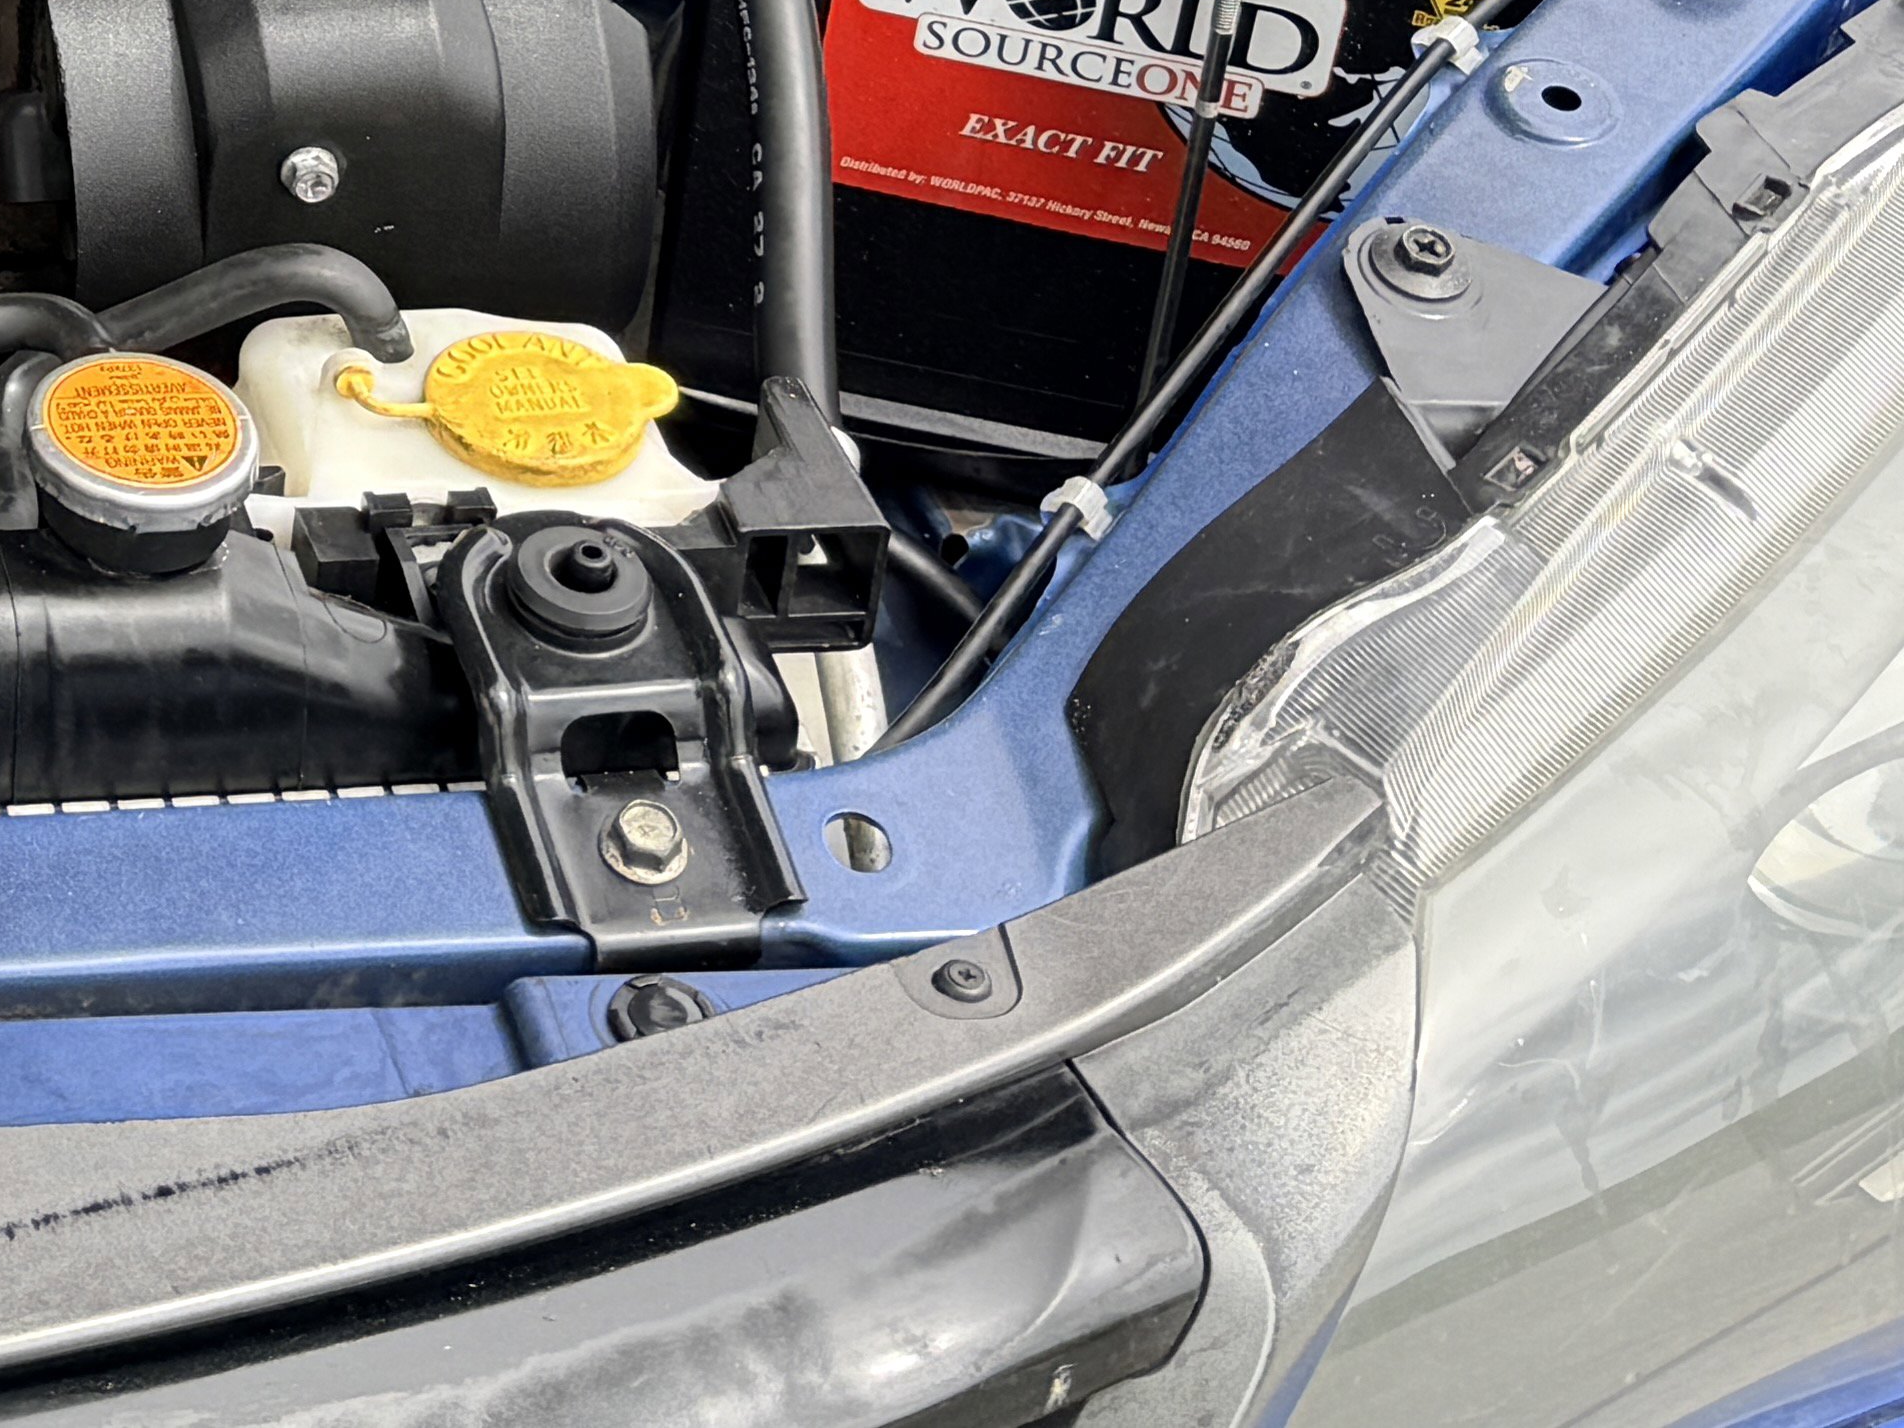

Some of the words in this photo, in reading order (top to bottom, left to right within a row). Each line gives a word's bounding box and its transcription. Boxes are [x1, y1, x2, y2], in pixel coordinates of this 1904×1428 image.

[922, 19, 1252, 114] SOURCEONE
[958, 112, 1091, 160] EXACT
[1097, 140, 1165, 175] FIT
[840, 156, 906, 182] Distributed
[1046, 200, 1093, 221] Hickory
[74, 382, 186, 398] AVERTISSEMENT
[495, 395, 586, 416] MANUAL
[95, 420, 138, 432] WHEN
[141, 418, 179, 429] OPEN
[183, 417, 227, 428] NEVER
[105, 455, 181, 469] WARNING
